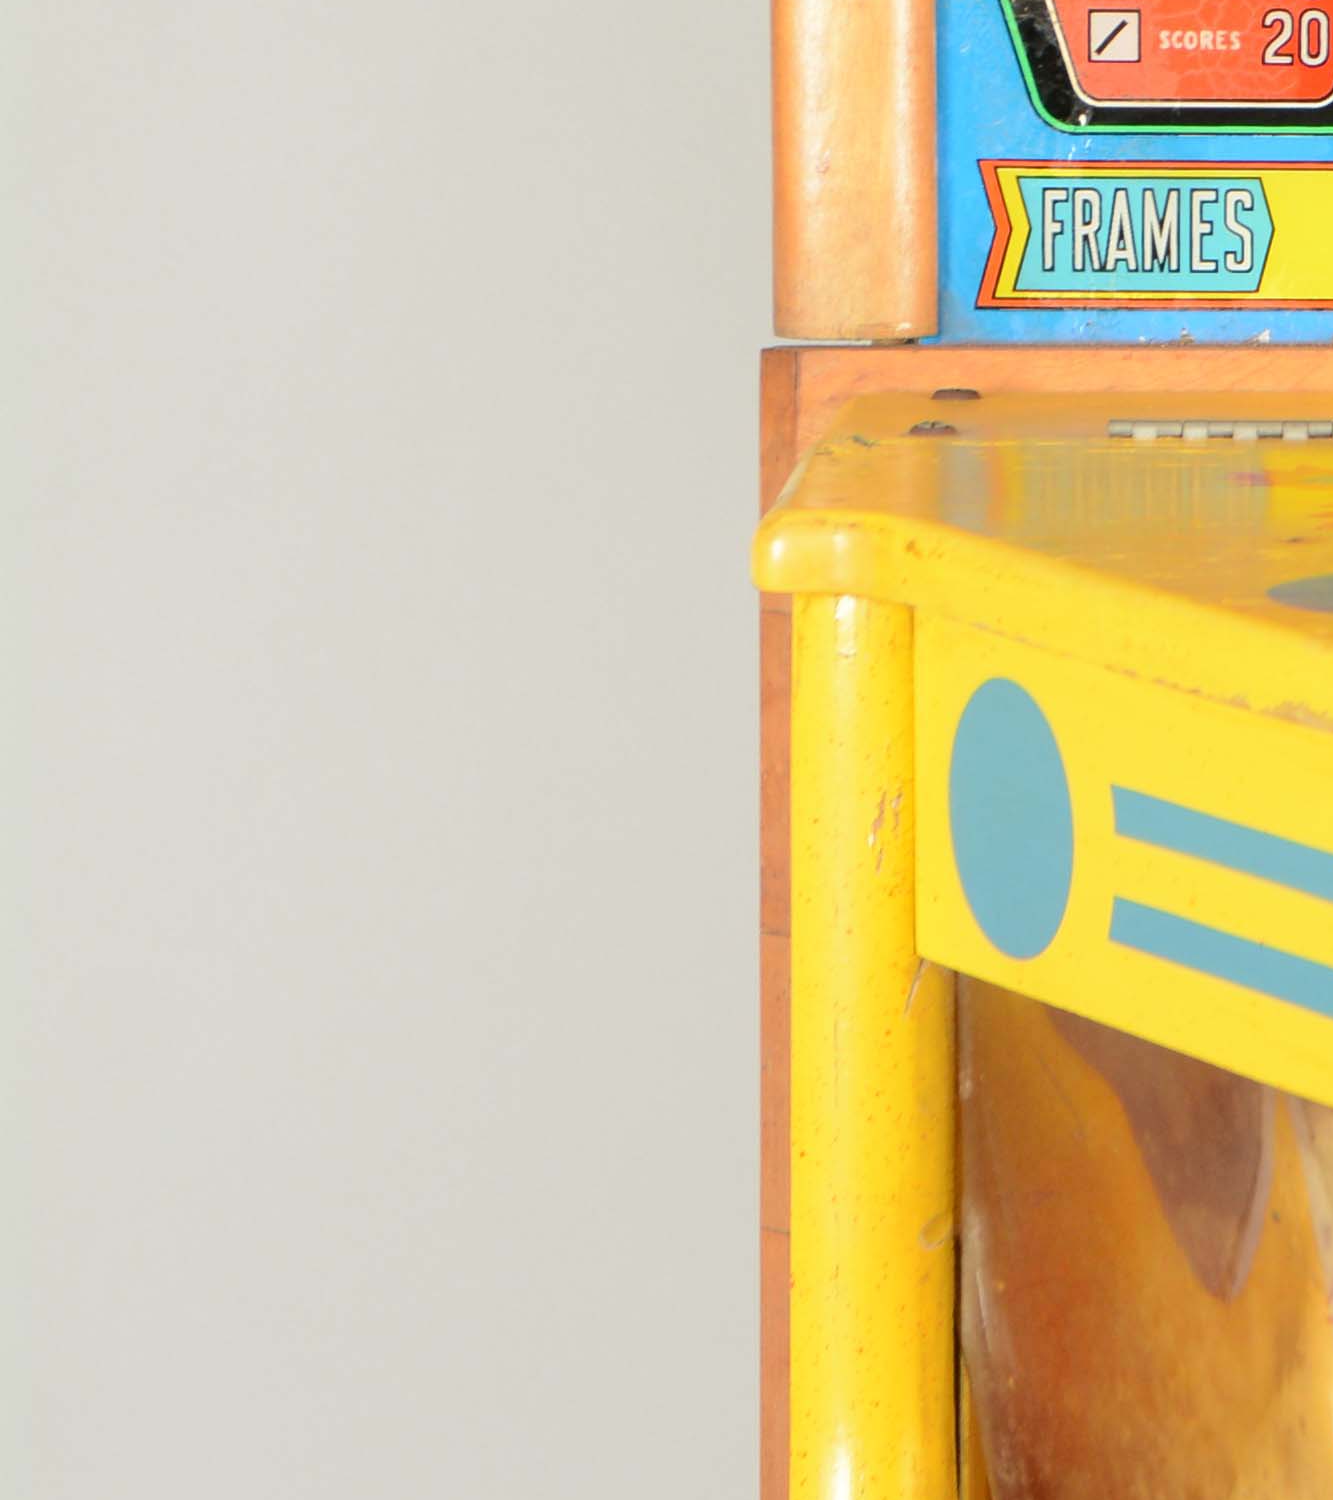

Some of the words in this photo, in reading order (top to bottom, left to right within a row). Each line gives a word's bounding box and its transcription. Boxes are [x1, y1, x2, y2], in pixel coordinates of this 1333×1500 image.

[1159, 30, 1242, 50] SCORES
[1261, 8, 1330, 67] 20
[1041, 187, 1255, 273] FRAMES
